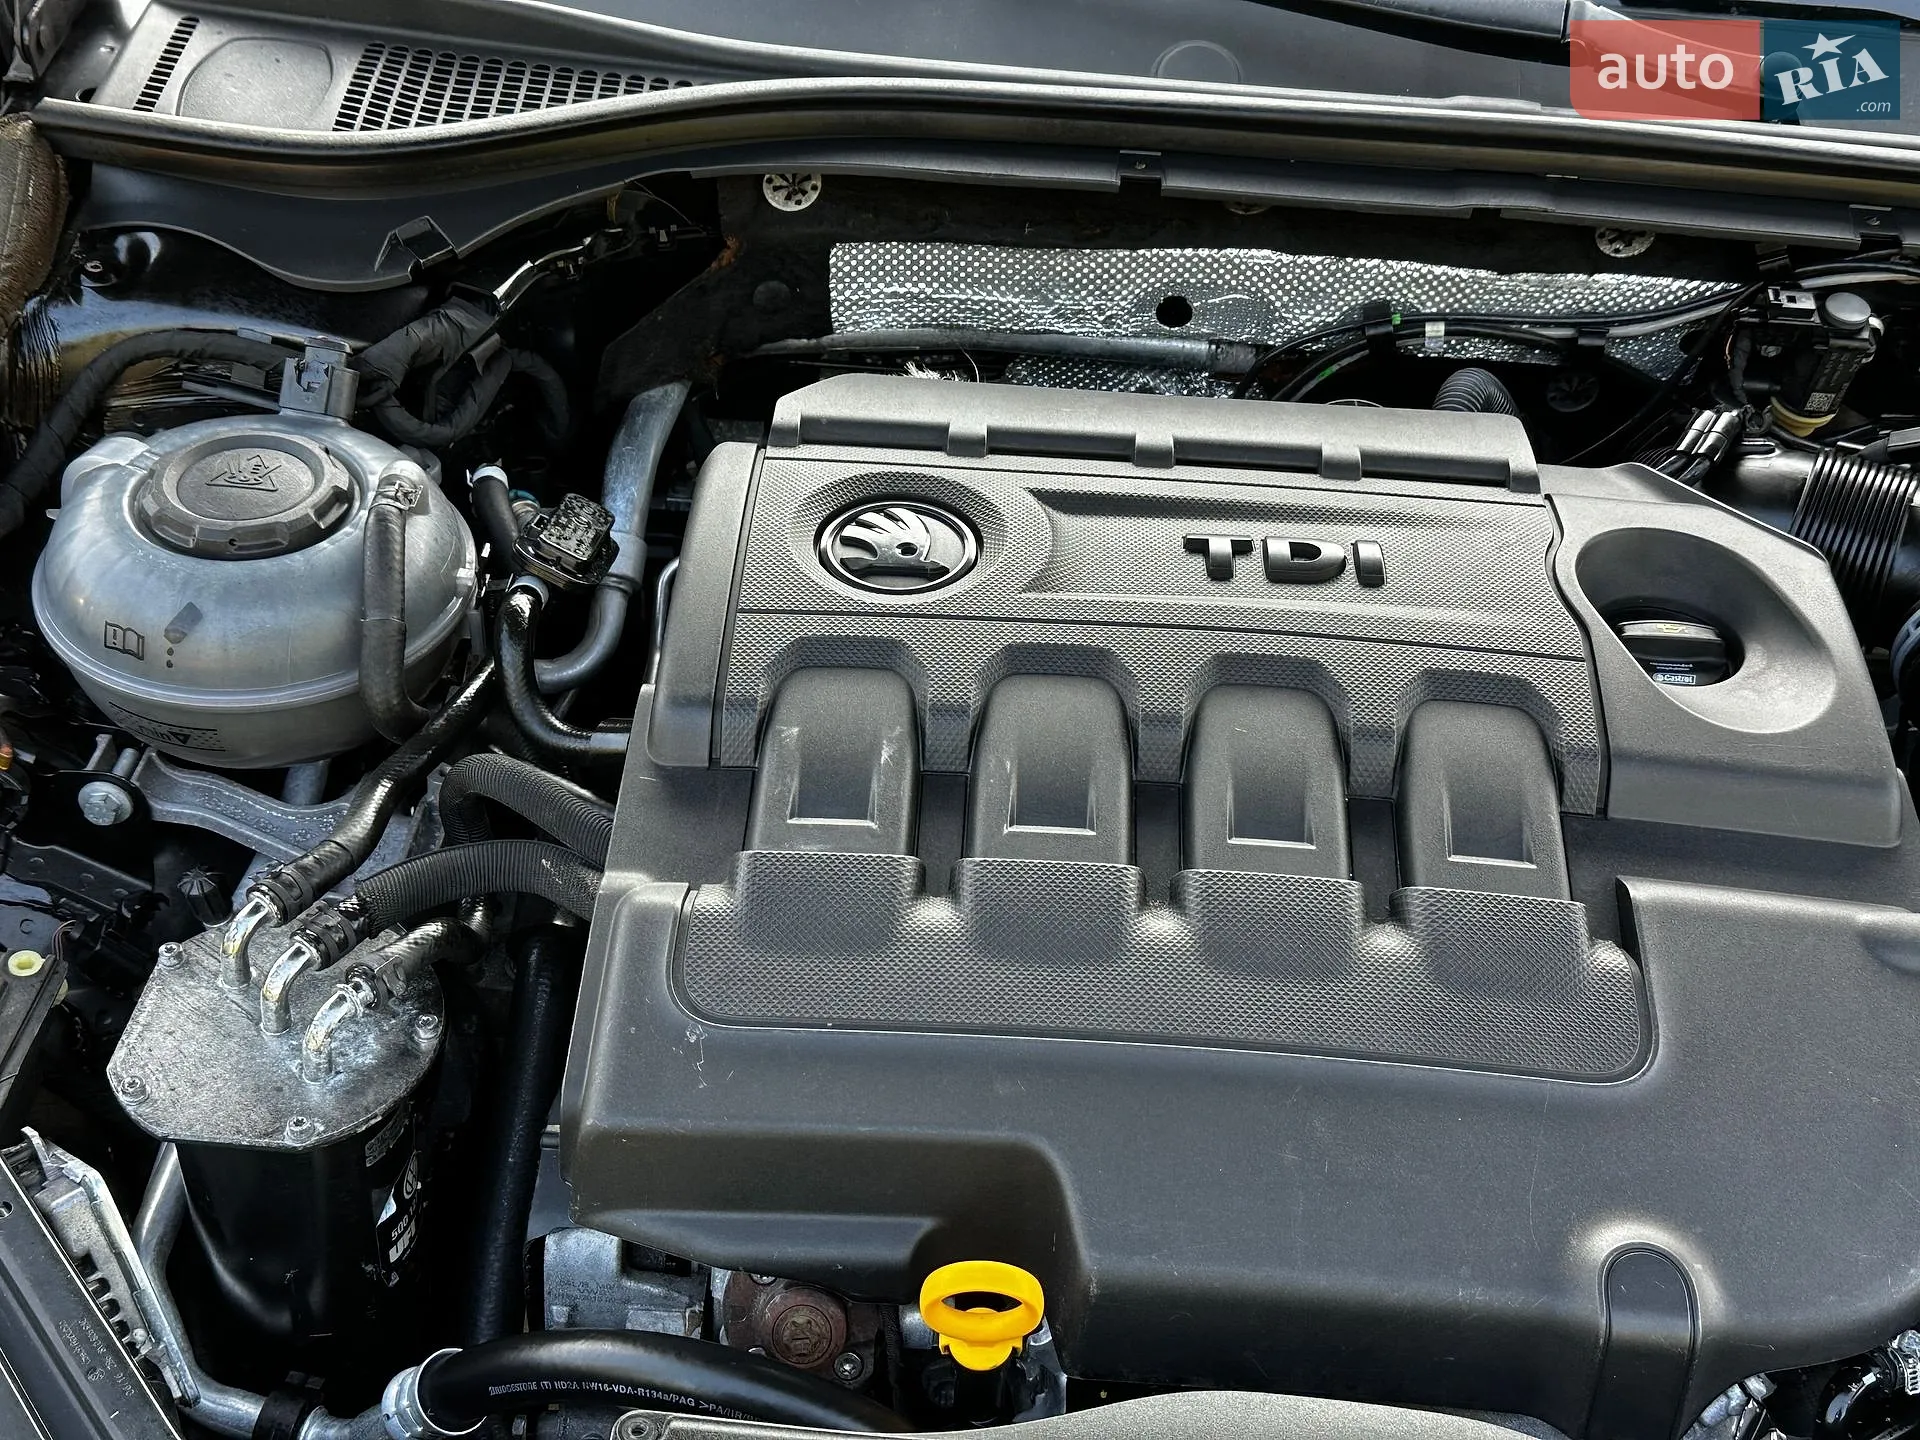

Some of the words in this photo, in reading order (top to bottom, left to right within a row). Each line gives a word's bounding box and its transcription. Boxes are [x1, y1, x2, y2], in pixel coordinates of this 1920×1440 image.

[1664, 674, 1693, 683] Castrol
[391, 1214, 409, 1241] 500
[540, 1380, 552, 1390] (T)
